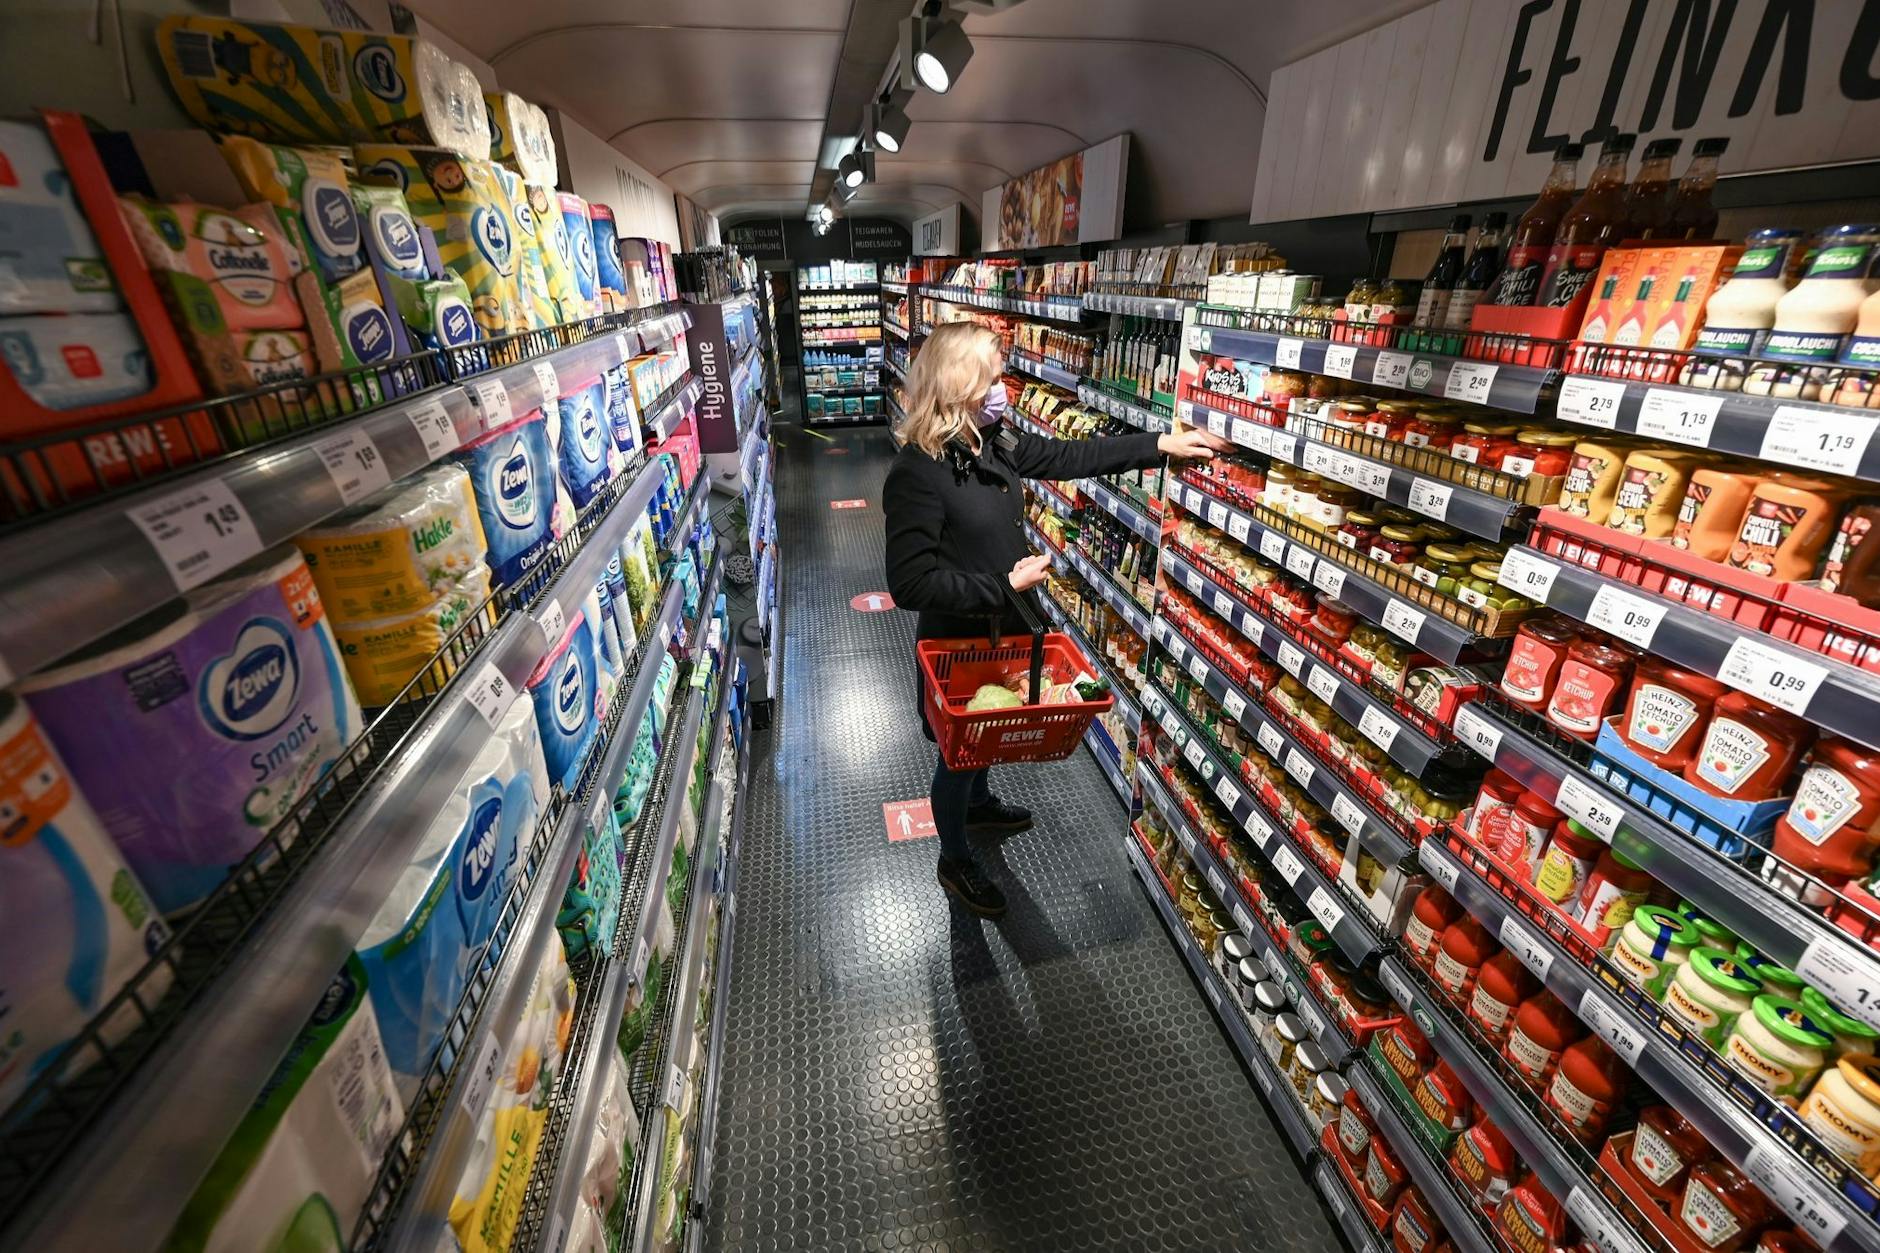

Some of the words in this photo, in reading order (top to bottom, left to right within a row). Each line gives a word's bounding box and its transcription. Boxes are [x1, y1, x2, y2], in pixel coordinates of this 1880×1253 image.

[855, 226, 893, 237] TEIGWAREN
[208, 248, 270, 271] Cottonelle
[1501, 264, 1538, 284] SWEET
[1500, 278, 1536, 298] CHILI
[700, 341, 726, 420] Hygiene
[1469, 376, 1488, 390] 2.49
[1589, 396, 1613, 413] 2.79
[1679, 410, 1707, 428] 1.19
[1818, 433, 1856, 453] 1.19
[1372, 475, 1385, 487] 3.29
[1566, 476, 1592, 493] SENF
[1428, 494, 1444, 508] 3.29
[1618, 490, 1648, 510] SENF
[1747, 514, 1783, 531] CHIPOTLE
[413, 516, 454, 554] Hakle
[1741, 523, 1782, 547] CHILI
[1526, 571, 1548, 586] 0.99
[1668, 577, 1725, 610] REWE
[1401, 617, 1417, 631] 2.29
[1624, 611, 1651, 629] 0.99
[1822, 632, 1880, 664] REW
[1512, 654, 1540, 672] KETCHUP
[227, 657, 283, 711] Zewa
[1563, 681, 1595, 702] KETCHUP
[1769, 670, 1806, 691] 0.99
[1642, 700, 1684, 722] TOMATO
[1651, 692, 1683, 709] HEINZ
[1641, 709, 1679, 727] KETCHUP
[251, 712, 319, 783] Smart
[1000, 729, 1046, 743] REWE
[1476, 731, 1494, 748] 0.99
[1713, 734, 1753, 761] TOMATO
[1722, 726, 1753, 747] HEINZ
[1711, 743, 1747, 767] KETCHUP
[1595, 764, 1628, 792] HINZ
[1816, 770, 1845, 794] HEINZ
[1803, 789, 1838, 816] KETCHUP
[1808, 779, 1844, 811] TOMATO
[1587, 806, 1613, 827] 2.59
[465, 812, 500, 888] Zew
[1525, 948, 1545, 968] 1.59
[1616, 942, 1650, 972] THOMY
[1670, 986, 1710, 1021] THOMY
[1857, 987, 1880, 1012] 1.4
[1610, 1027, 1635, 1051] 1.99
[1734, 1040, 1785, 1079] THOMY
[1815, 1101, 1876, 1145] THOMY
[1640, 1135, 1673, 1167] TOMATO
[1647, 1129, 1672, 1156] HEINZ
[1641, 1142, 1670, 1171] KETCHUP
[1691, 1193, 1727, 1228] TOMATO
[1699, 1187, 1728, 1215] HEINZ
[1793, 1196, 1829, 1230] 1.69
